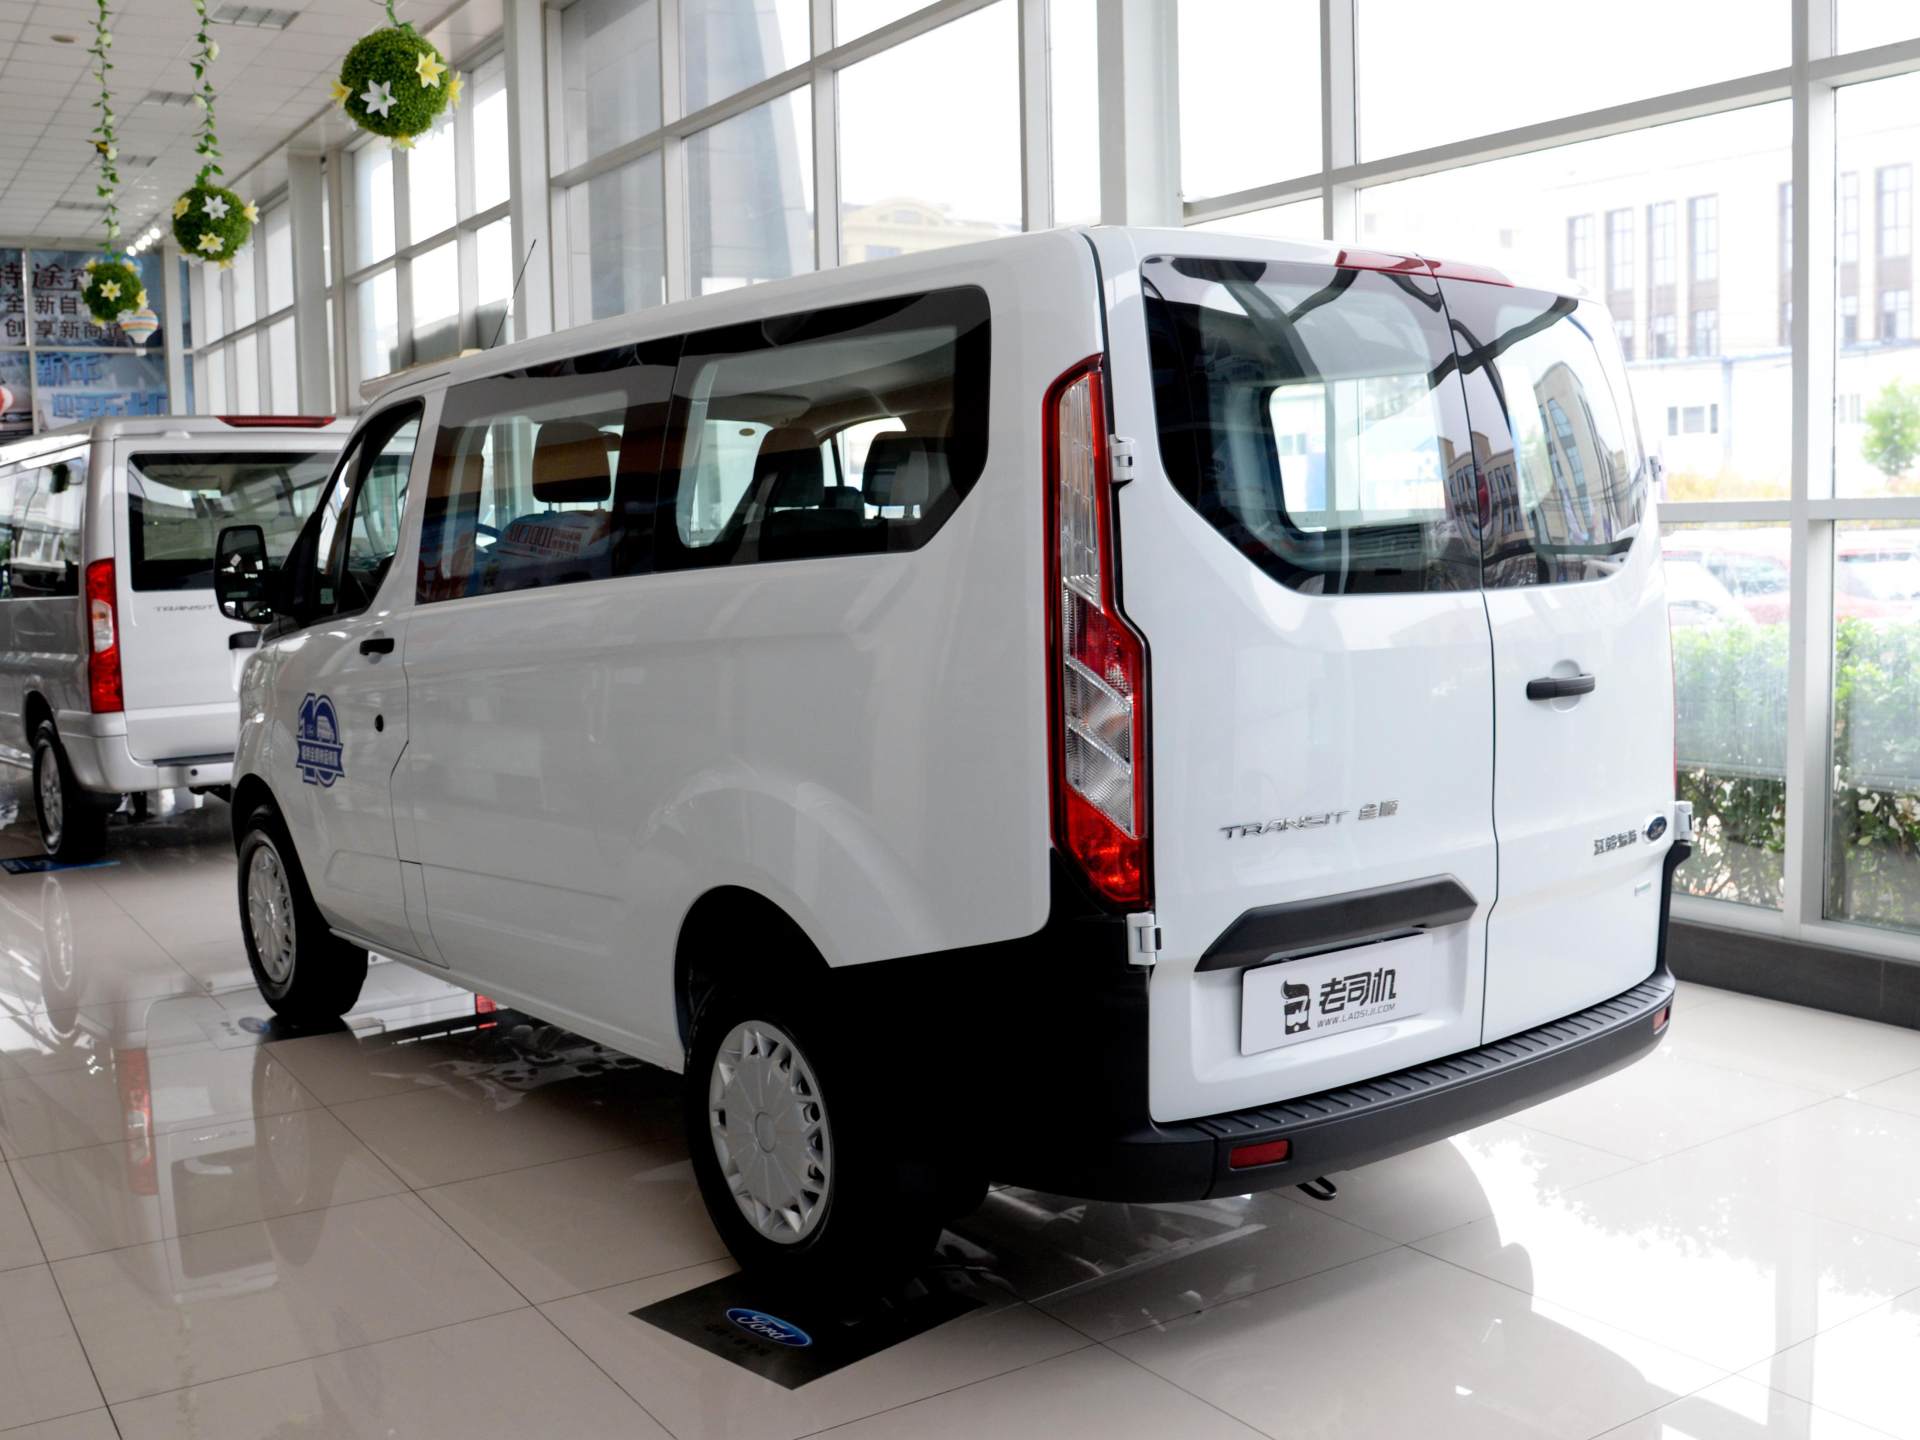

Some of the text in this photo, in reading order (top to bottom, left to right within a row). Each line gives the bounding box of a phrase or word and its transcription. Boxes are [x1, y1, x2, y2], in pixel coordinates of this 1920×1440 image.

[1219, 810, 1352, 840] TRANSIT
[1318, 967, 1397, 1015] 老司机
[1317, 1003, 1396, 1028] WWW.LAOSIJI.COM
[736, 1314, 796, 1341] Ford
